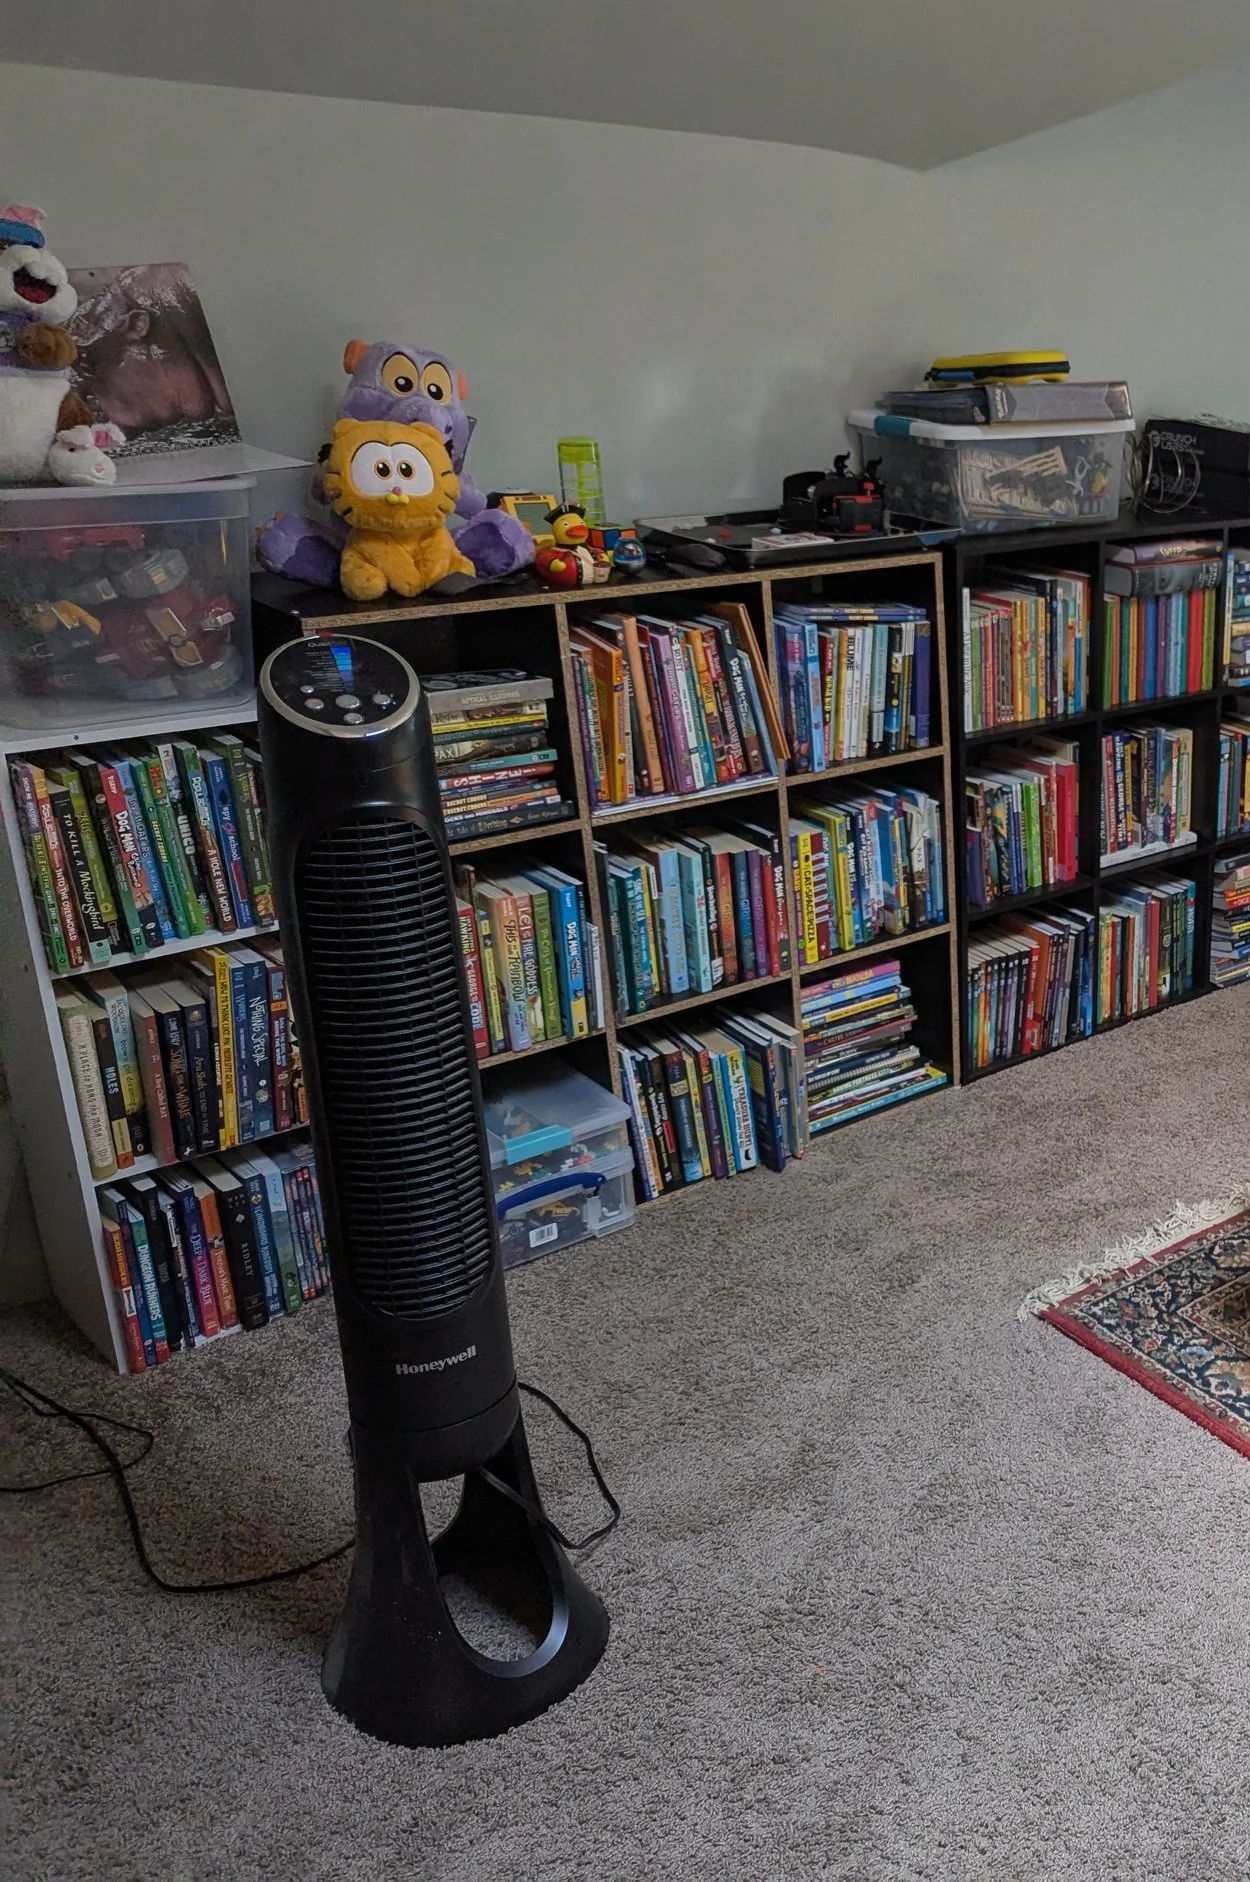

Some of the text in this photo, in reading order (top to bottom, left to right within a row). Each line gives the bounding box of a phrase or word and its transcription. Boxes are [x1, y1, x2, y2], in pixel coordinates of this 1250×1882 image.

[1160, 432, 1197, 446] CRUNCH
[673, 648, 683, 672] RUST
[728, 657, 741, 675] DOG
[846, 637, 854, 671] BLUME
[732, 675, 745, 693] MAN
[824, 675, 832, 711] NINJA KID
[460, 694, 487, 706] OPTICAL
[113, 810, 131, 833] DOG
[176, 814, 196, 855] UNICO
[220, 805, 240, 861] spy school
[67, 830, 81, 856] KILL
[120, 832, 137, 853] MAN
[150, 819, 168, 863] SECRET CODERS
[209, 856, 221, 877] HOLE
[846, 841, 856, 872] DOG MAN
[38, 859, 52, 888] EINSTEIN
[214, 877, 225, 895] NEW
[773, 865, 784, 897] DOG MAN
[792, 868, 801, 891] BARB
[54, 868, 76, 941] INTO THE OVERWORLD
[72, 869, 104, 932] Mockingbird
[218, 895, 231, 922] WORLD
[802, 870, 816, 943] CAT SPACE PIZZA
[636, 910, 645, 921] SEA
[740, 898, 751, 937] GRIMM
[502, 919, 518, 943] THIS
[566, 921, 578, 955] DOG MAN
[517, 906, 539, 995] LEI FIRE GODDESS
[457, 915, 482, 1030] HAWKING GEORGE CODE
[507, 954, 525, 1002] RAINBOW
[219, 1004, 229, 1022] THINK
[248, 996, 267, 1066] NOTHING SPECIAL
[77, 1050, 91, 1073] PLACE
[120, 1039, 130, 1060] brown
[83, 1083, 96, 1103] HANG
[103, 1066, 119, 1094] HOLES
[124, 1075, 137, 1106] dreaming
[88, 1104, 98, 1116] the
[175, 1090, 191, 1118] WHALE
[136, 1244, 155, 1283] DUNGEON
[189, 1234, 212, 1306] DEEP DARK BLUE
[239, 1242, 253, 1277] RIDLEY
[144, 1283, 162, 1320] RUNNERS
[395, 1345, 477, 1375] Honeywell
